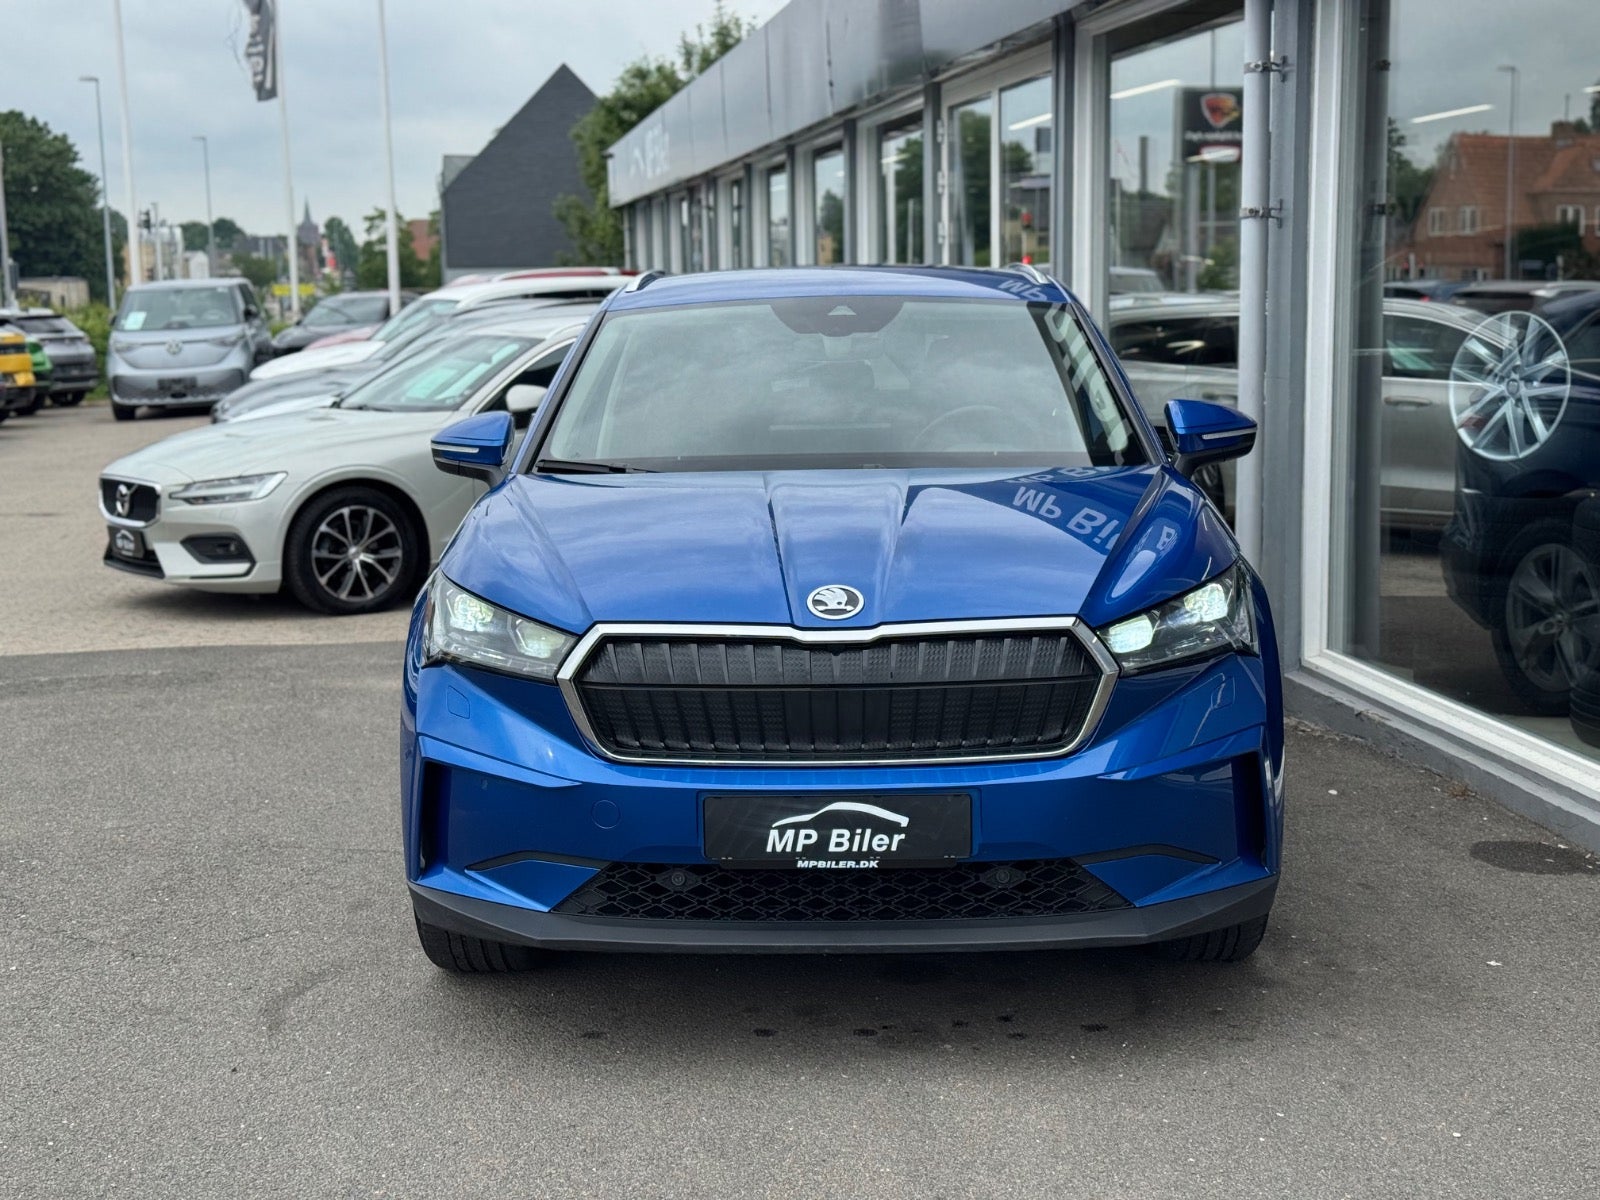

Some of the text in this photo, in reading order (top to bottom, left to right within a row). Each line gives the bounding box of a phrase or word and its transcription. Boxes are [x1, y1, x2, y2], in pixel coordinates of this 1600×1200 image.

[766, 828, 906, 852] MP Biler
[797, 860, 879, 869] MPBILER.DK
